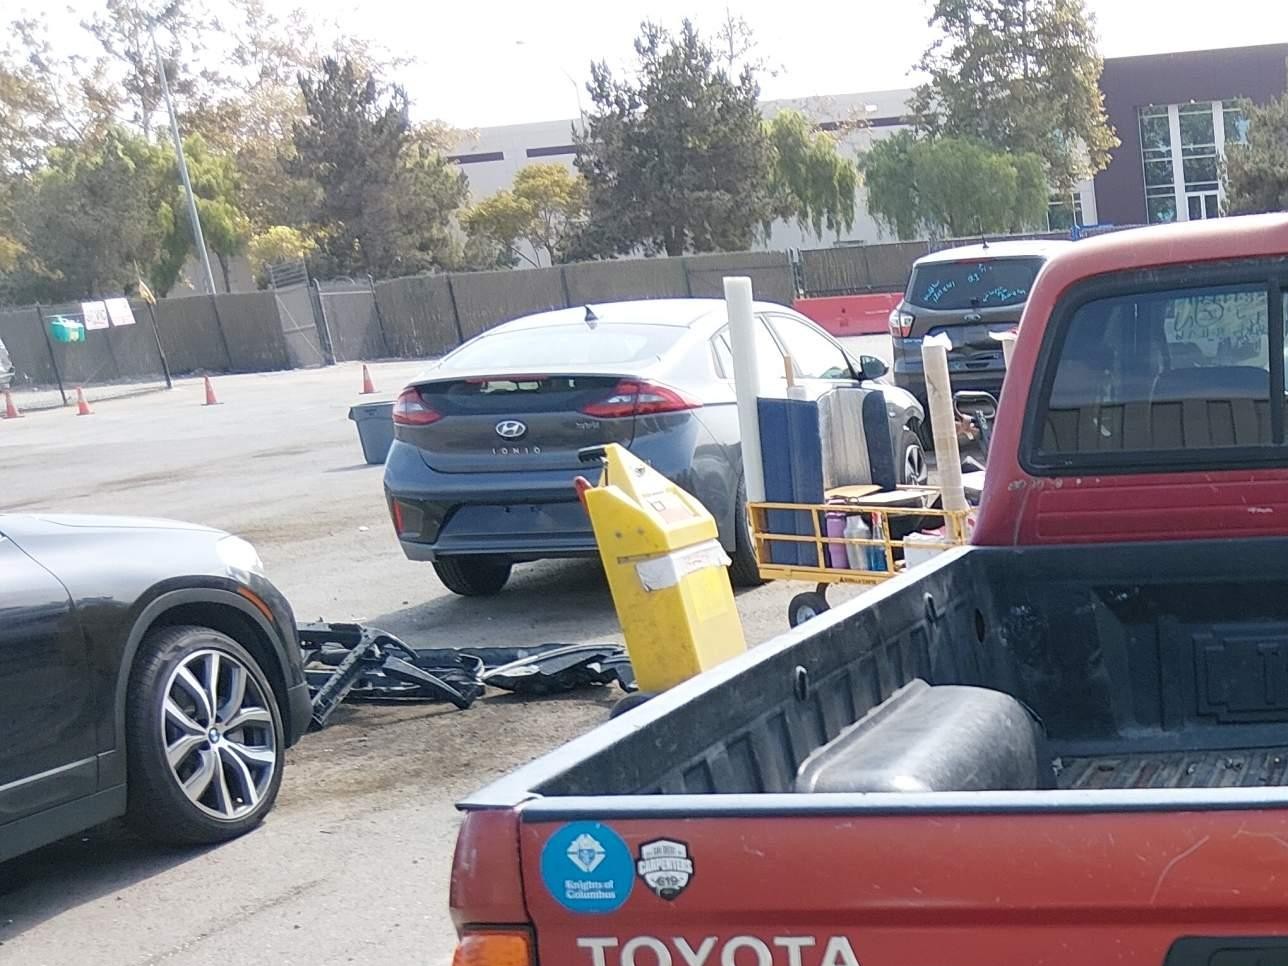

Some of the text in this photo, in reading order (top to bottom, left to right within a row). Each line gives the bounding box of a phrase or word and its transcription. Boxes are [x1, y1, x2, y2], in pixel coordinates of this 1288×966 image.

[565, 880, 614, 891] Knights of
[566, 890, 616, 899] Columbus
